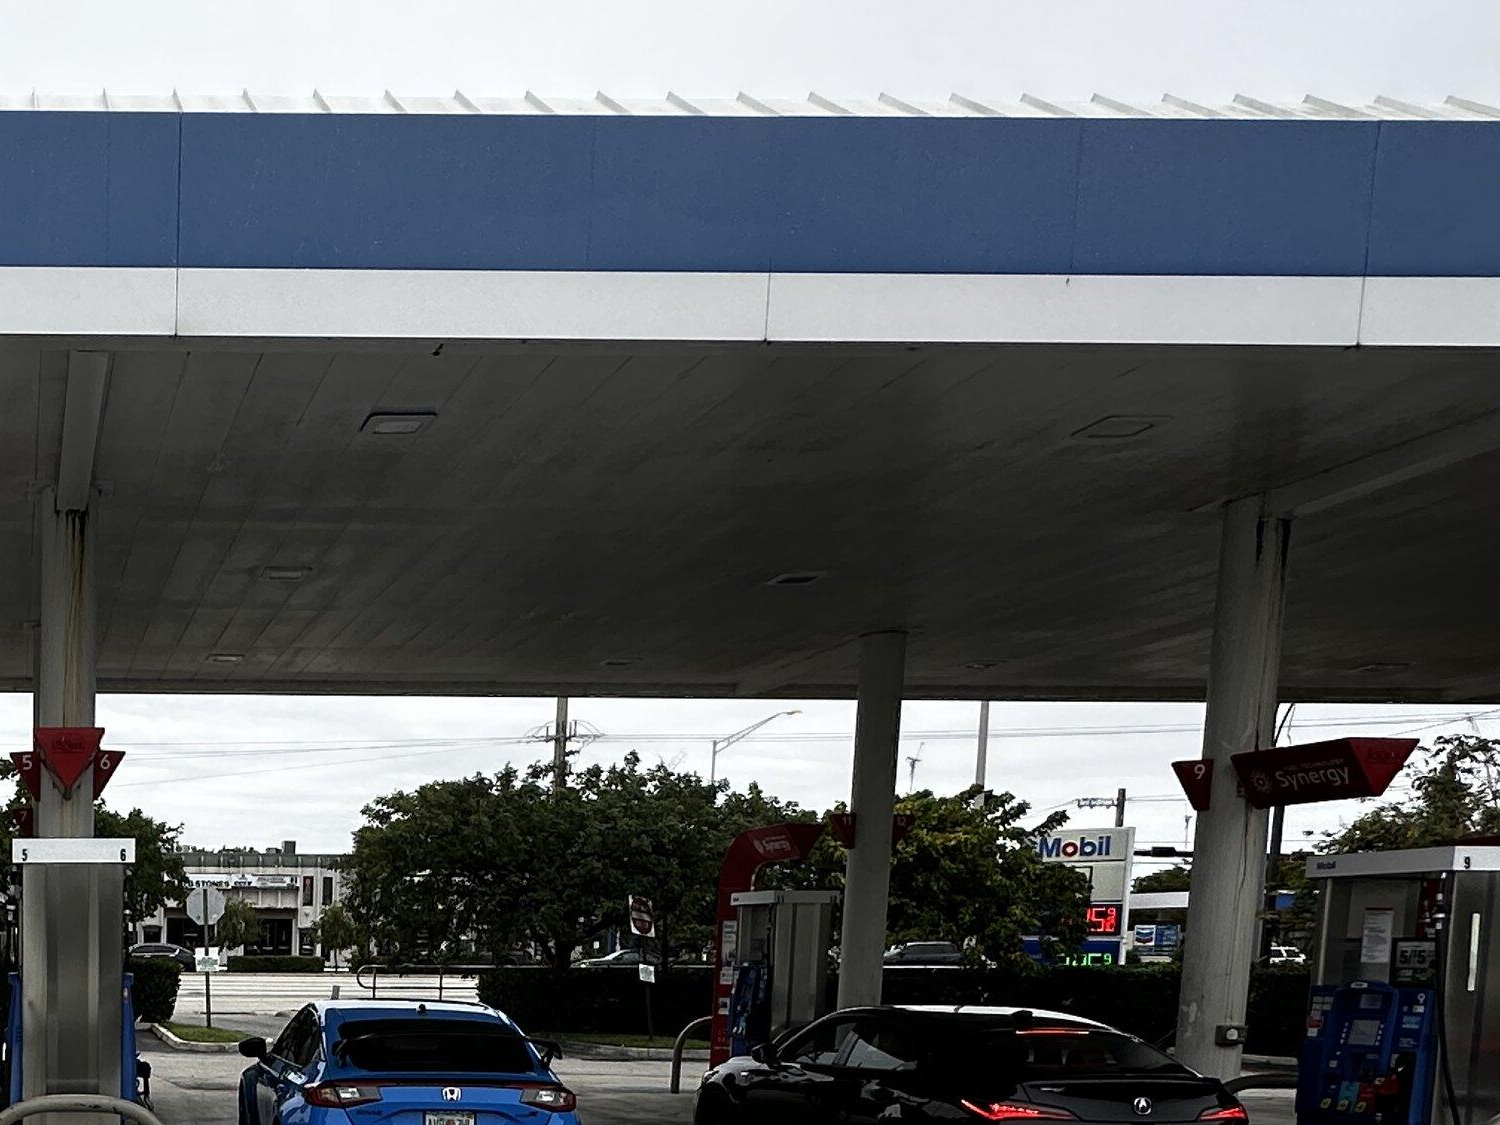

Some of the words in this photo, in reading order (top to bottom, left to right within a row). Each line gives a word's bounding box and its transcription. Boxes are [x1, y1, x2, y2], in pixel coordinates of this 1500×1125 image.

[22, 755, 33, 770] 5
[100, 755, 111, 770] 6
[1193, 763, 1206, 780] 9
[1275, 766, 1349, 791] Synergy
[19, 810, 27, 822] 7
[1038, 835, 1112, 858] Mobil
[21, 848, 28, 862] 5
[119, 848, 127, 862] 6
[1316, 861, 1337, 871] Mobil
[1464, 856, 1471, 869] 9
